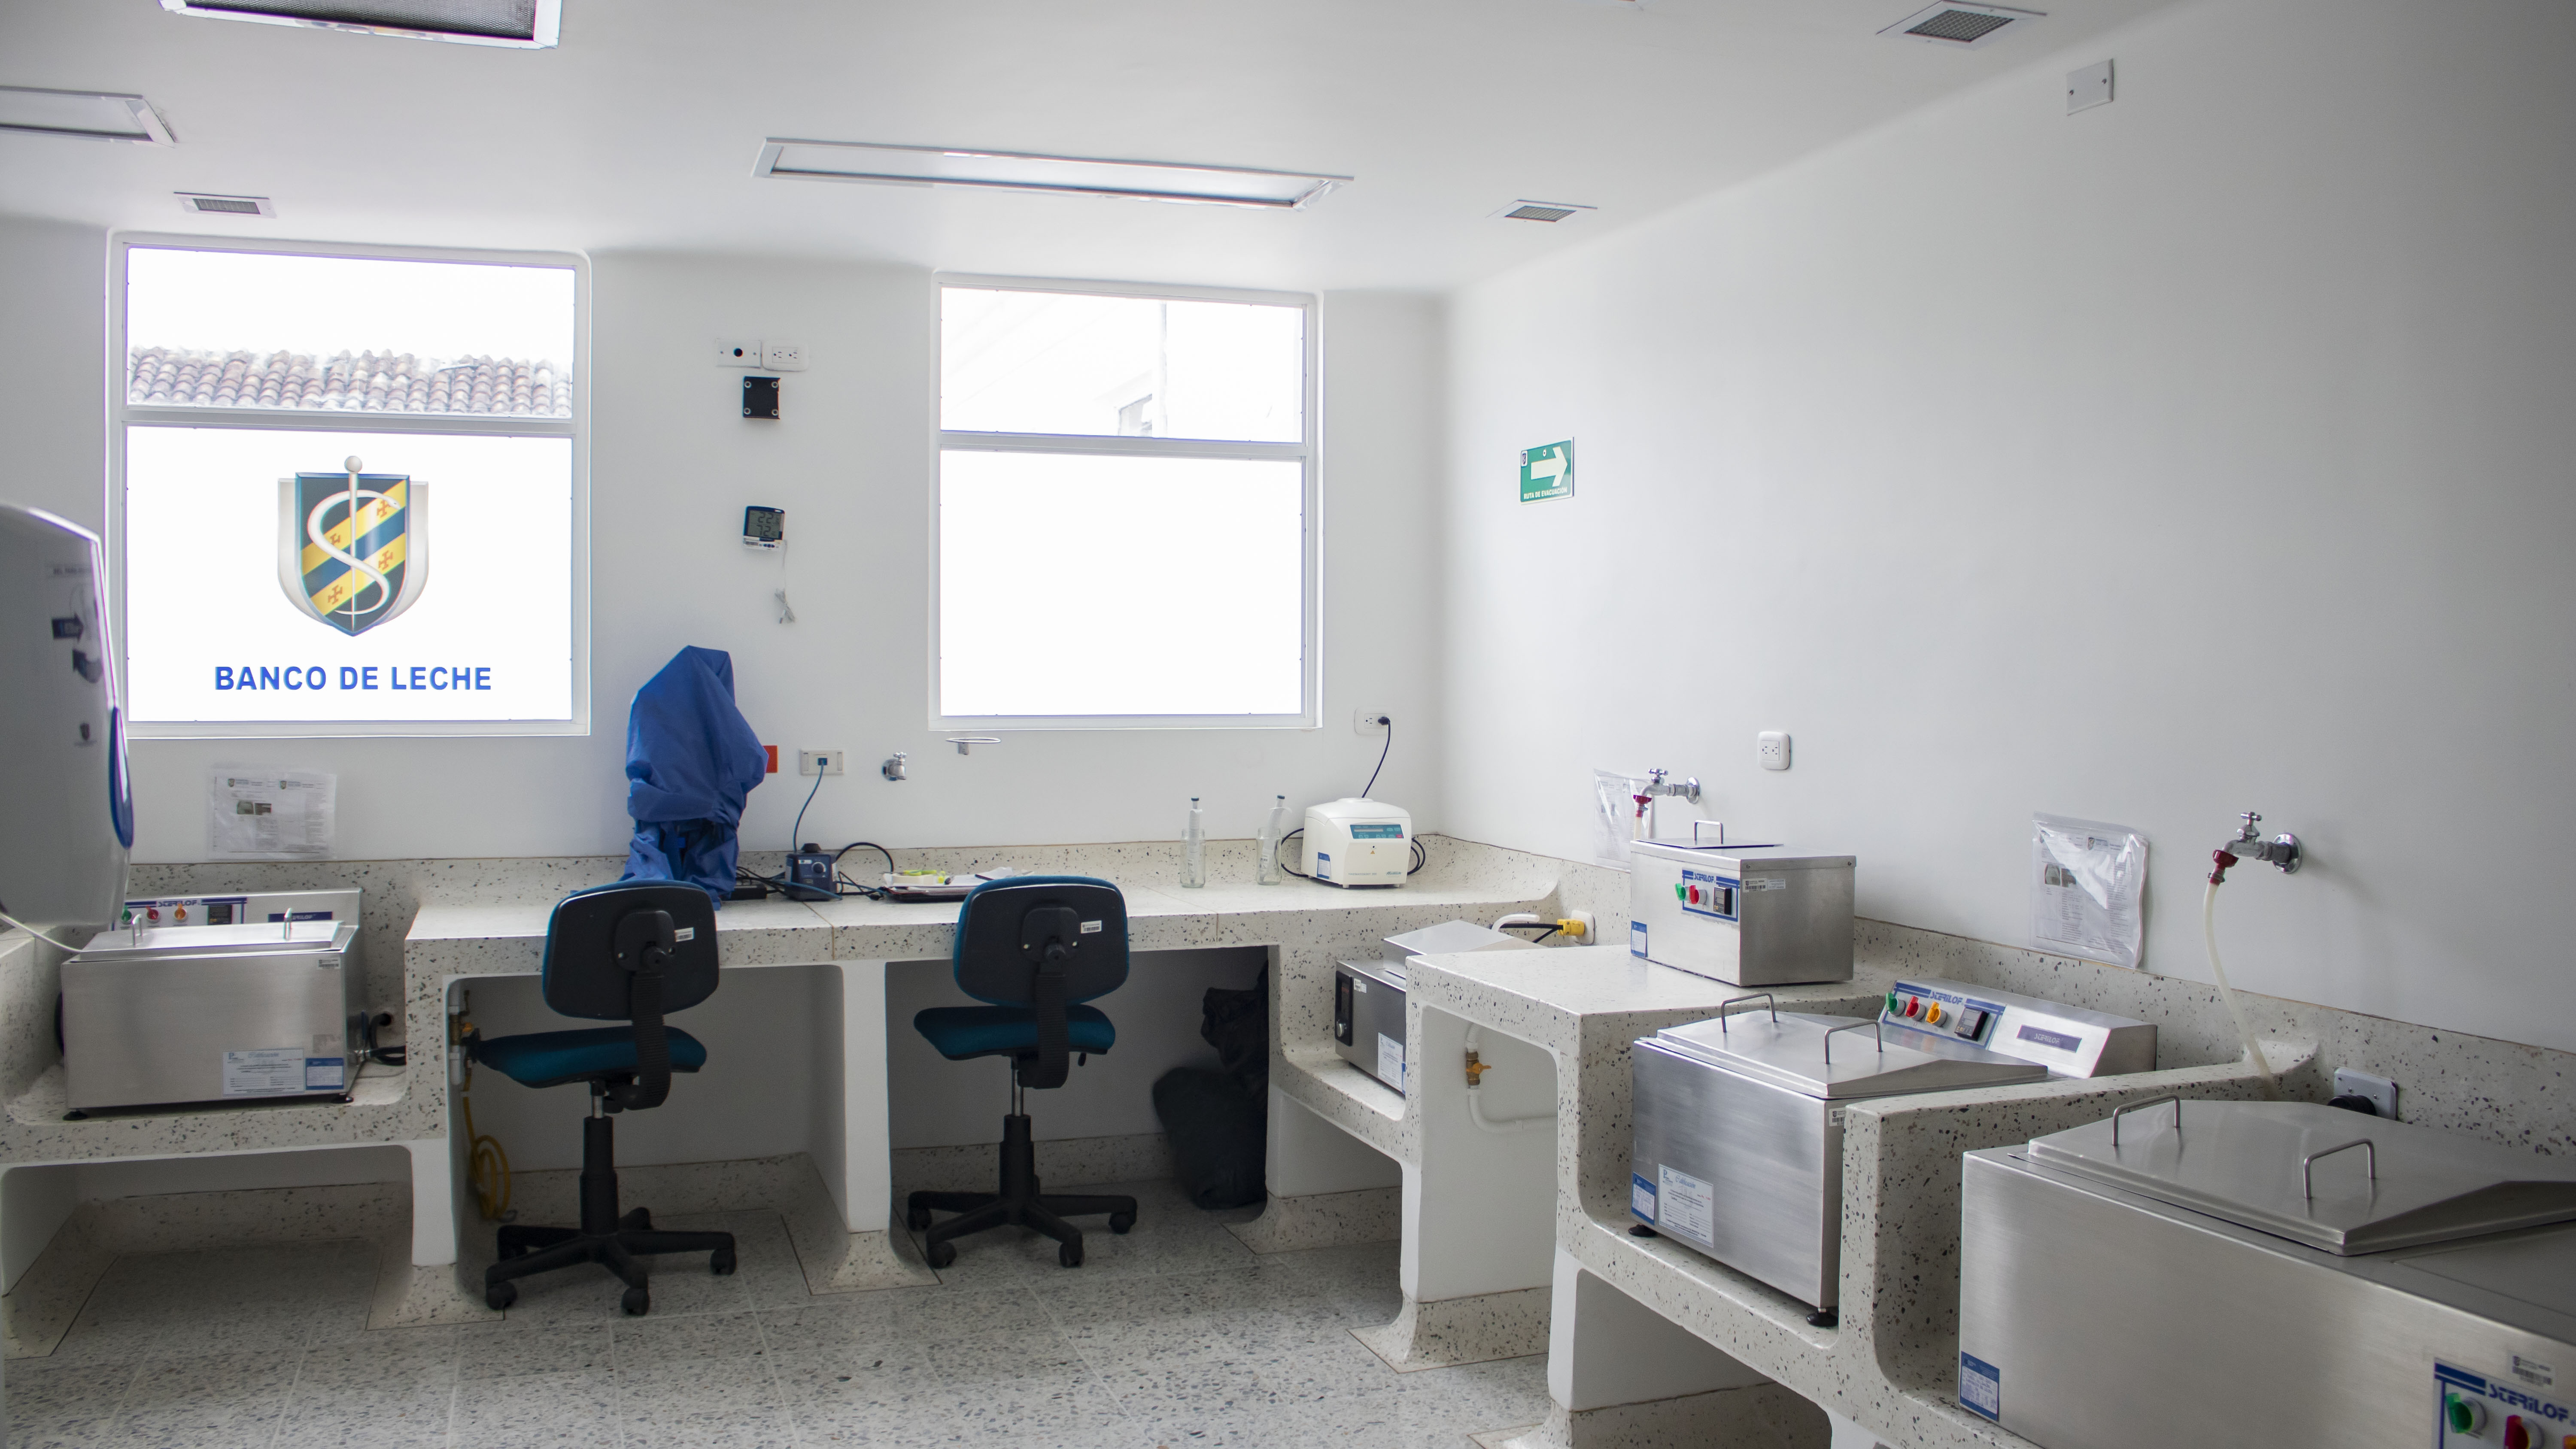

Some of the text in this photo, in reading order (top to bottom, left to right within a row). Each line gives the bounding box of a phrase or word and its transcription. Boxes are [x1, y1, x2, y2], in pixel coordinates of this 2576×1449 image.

[758, 512, 773, 524] 22
[756, 524, 771, 537] 72
[215, 666, 491, 690] BANCO DE LECHE
